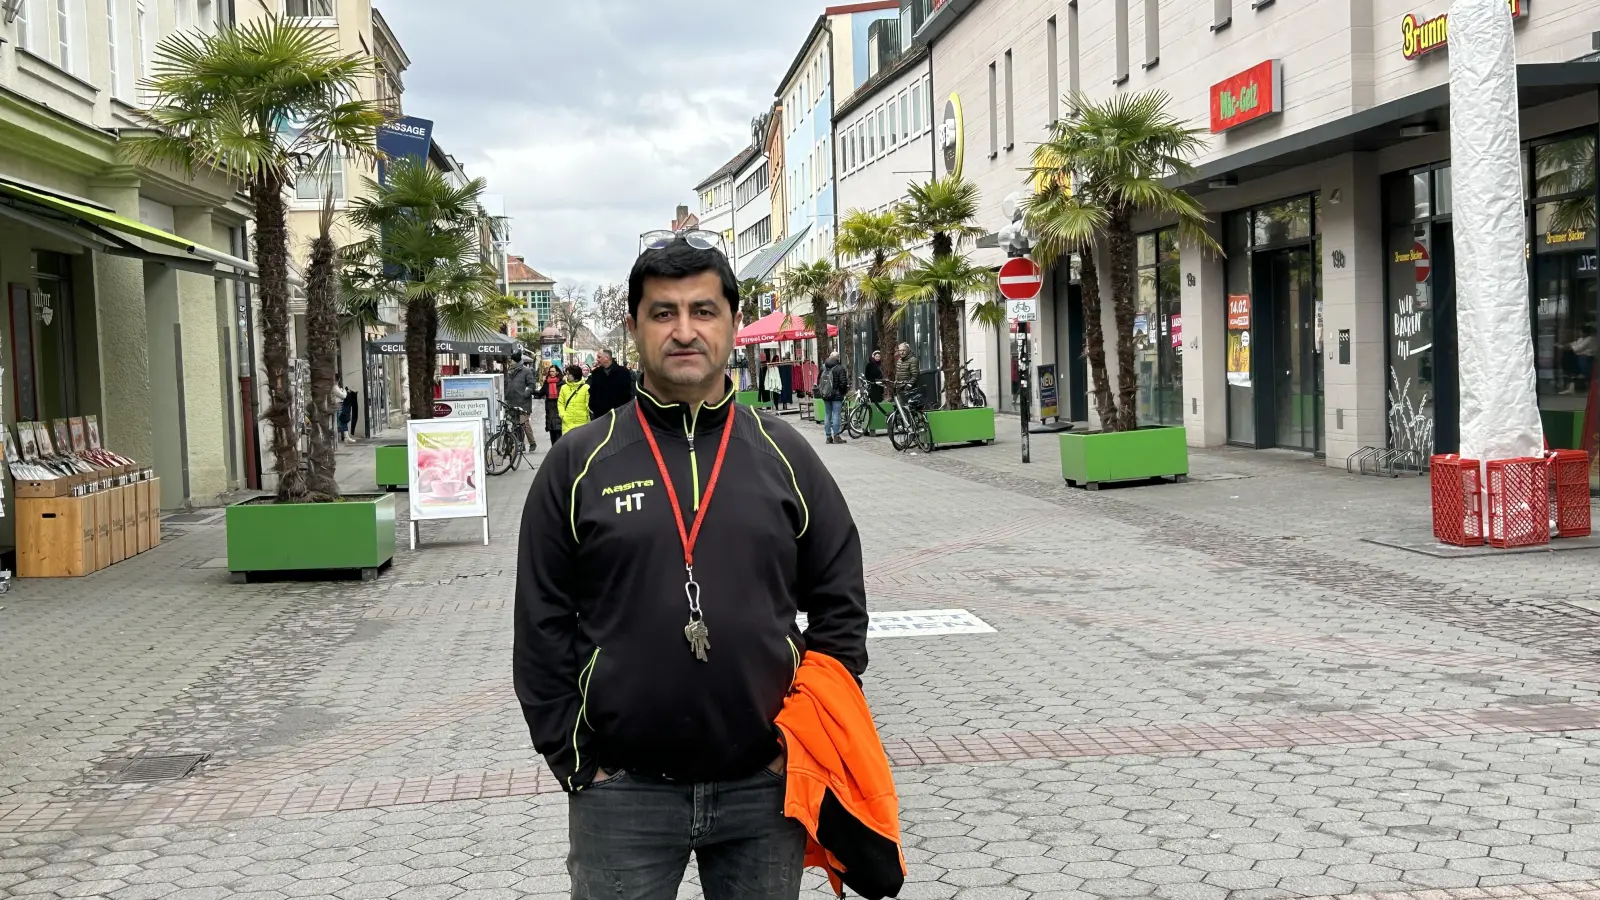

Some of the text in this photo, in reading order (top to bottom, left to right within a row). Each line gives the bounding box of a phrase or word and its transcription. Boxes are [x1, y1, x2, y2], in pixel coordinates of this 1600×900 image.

[1402, 14, 1447, 58] Brunn
[1398, 294, 1413, 315] WIR
[381, 344, 406, 352] CECIL
[435, 342, 453, 351] ECIL
[478, 345, 502, 353] CECIL
[615, 492, 645, 514] HT
